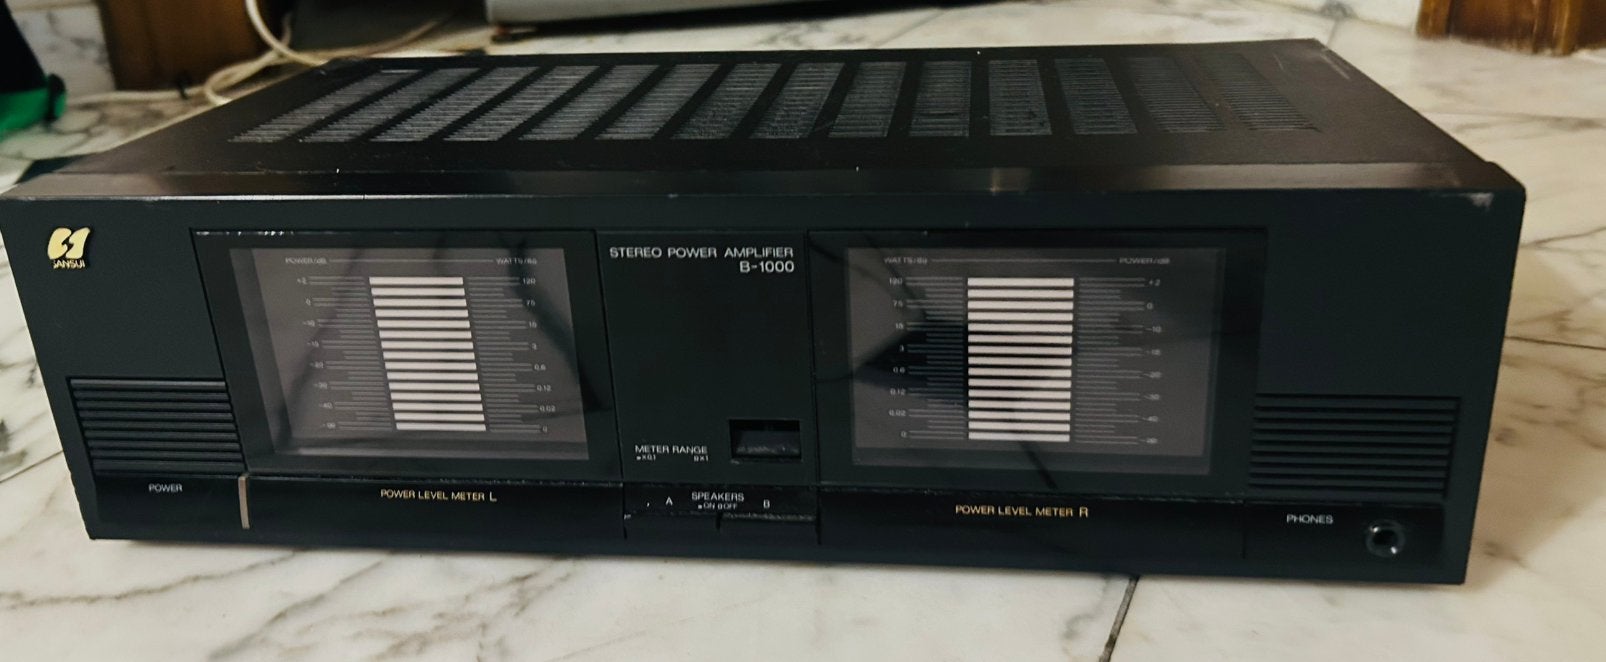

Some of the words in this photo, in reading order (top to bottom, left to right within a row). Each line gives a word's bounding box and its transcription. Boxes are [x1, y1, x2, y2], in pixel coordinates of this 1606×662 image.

[609, 247, 662, 258] STEREO
[668, 247, 717, 258] POWER
[724, 247, 794, 258] AMPLIFIER
[739, 260, 795, 273] B-1000
[634, 444, 669, 454] METER
[672, 445, 708, 455] RANGE
[148, 483, 183, 493] POWER
[380, 488, 415, 499] POWER
[418, 490, 448, 500] LEVEL
[451, 491, 485, 501] METER
[489, 491, 498, 503] L
[665, 496, 674, 506] A
[691, 491, 745, 502] SPEAKERS
[703, 502, 716, 510] ON
[763, 499, 771, 509] B
[955, 504, 995, 515] POWER
[998, 505, 1032, 516] LEVEL
[1035, 506, 1073, 517] METER
[1079, 506, 1089, 518] R
[1286, 514, 1334, 525] PHONES
